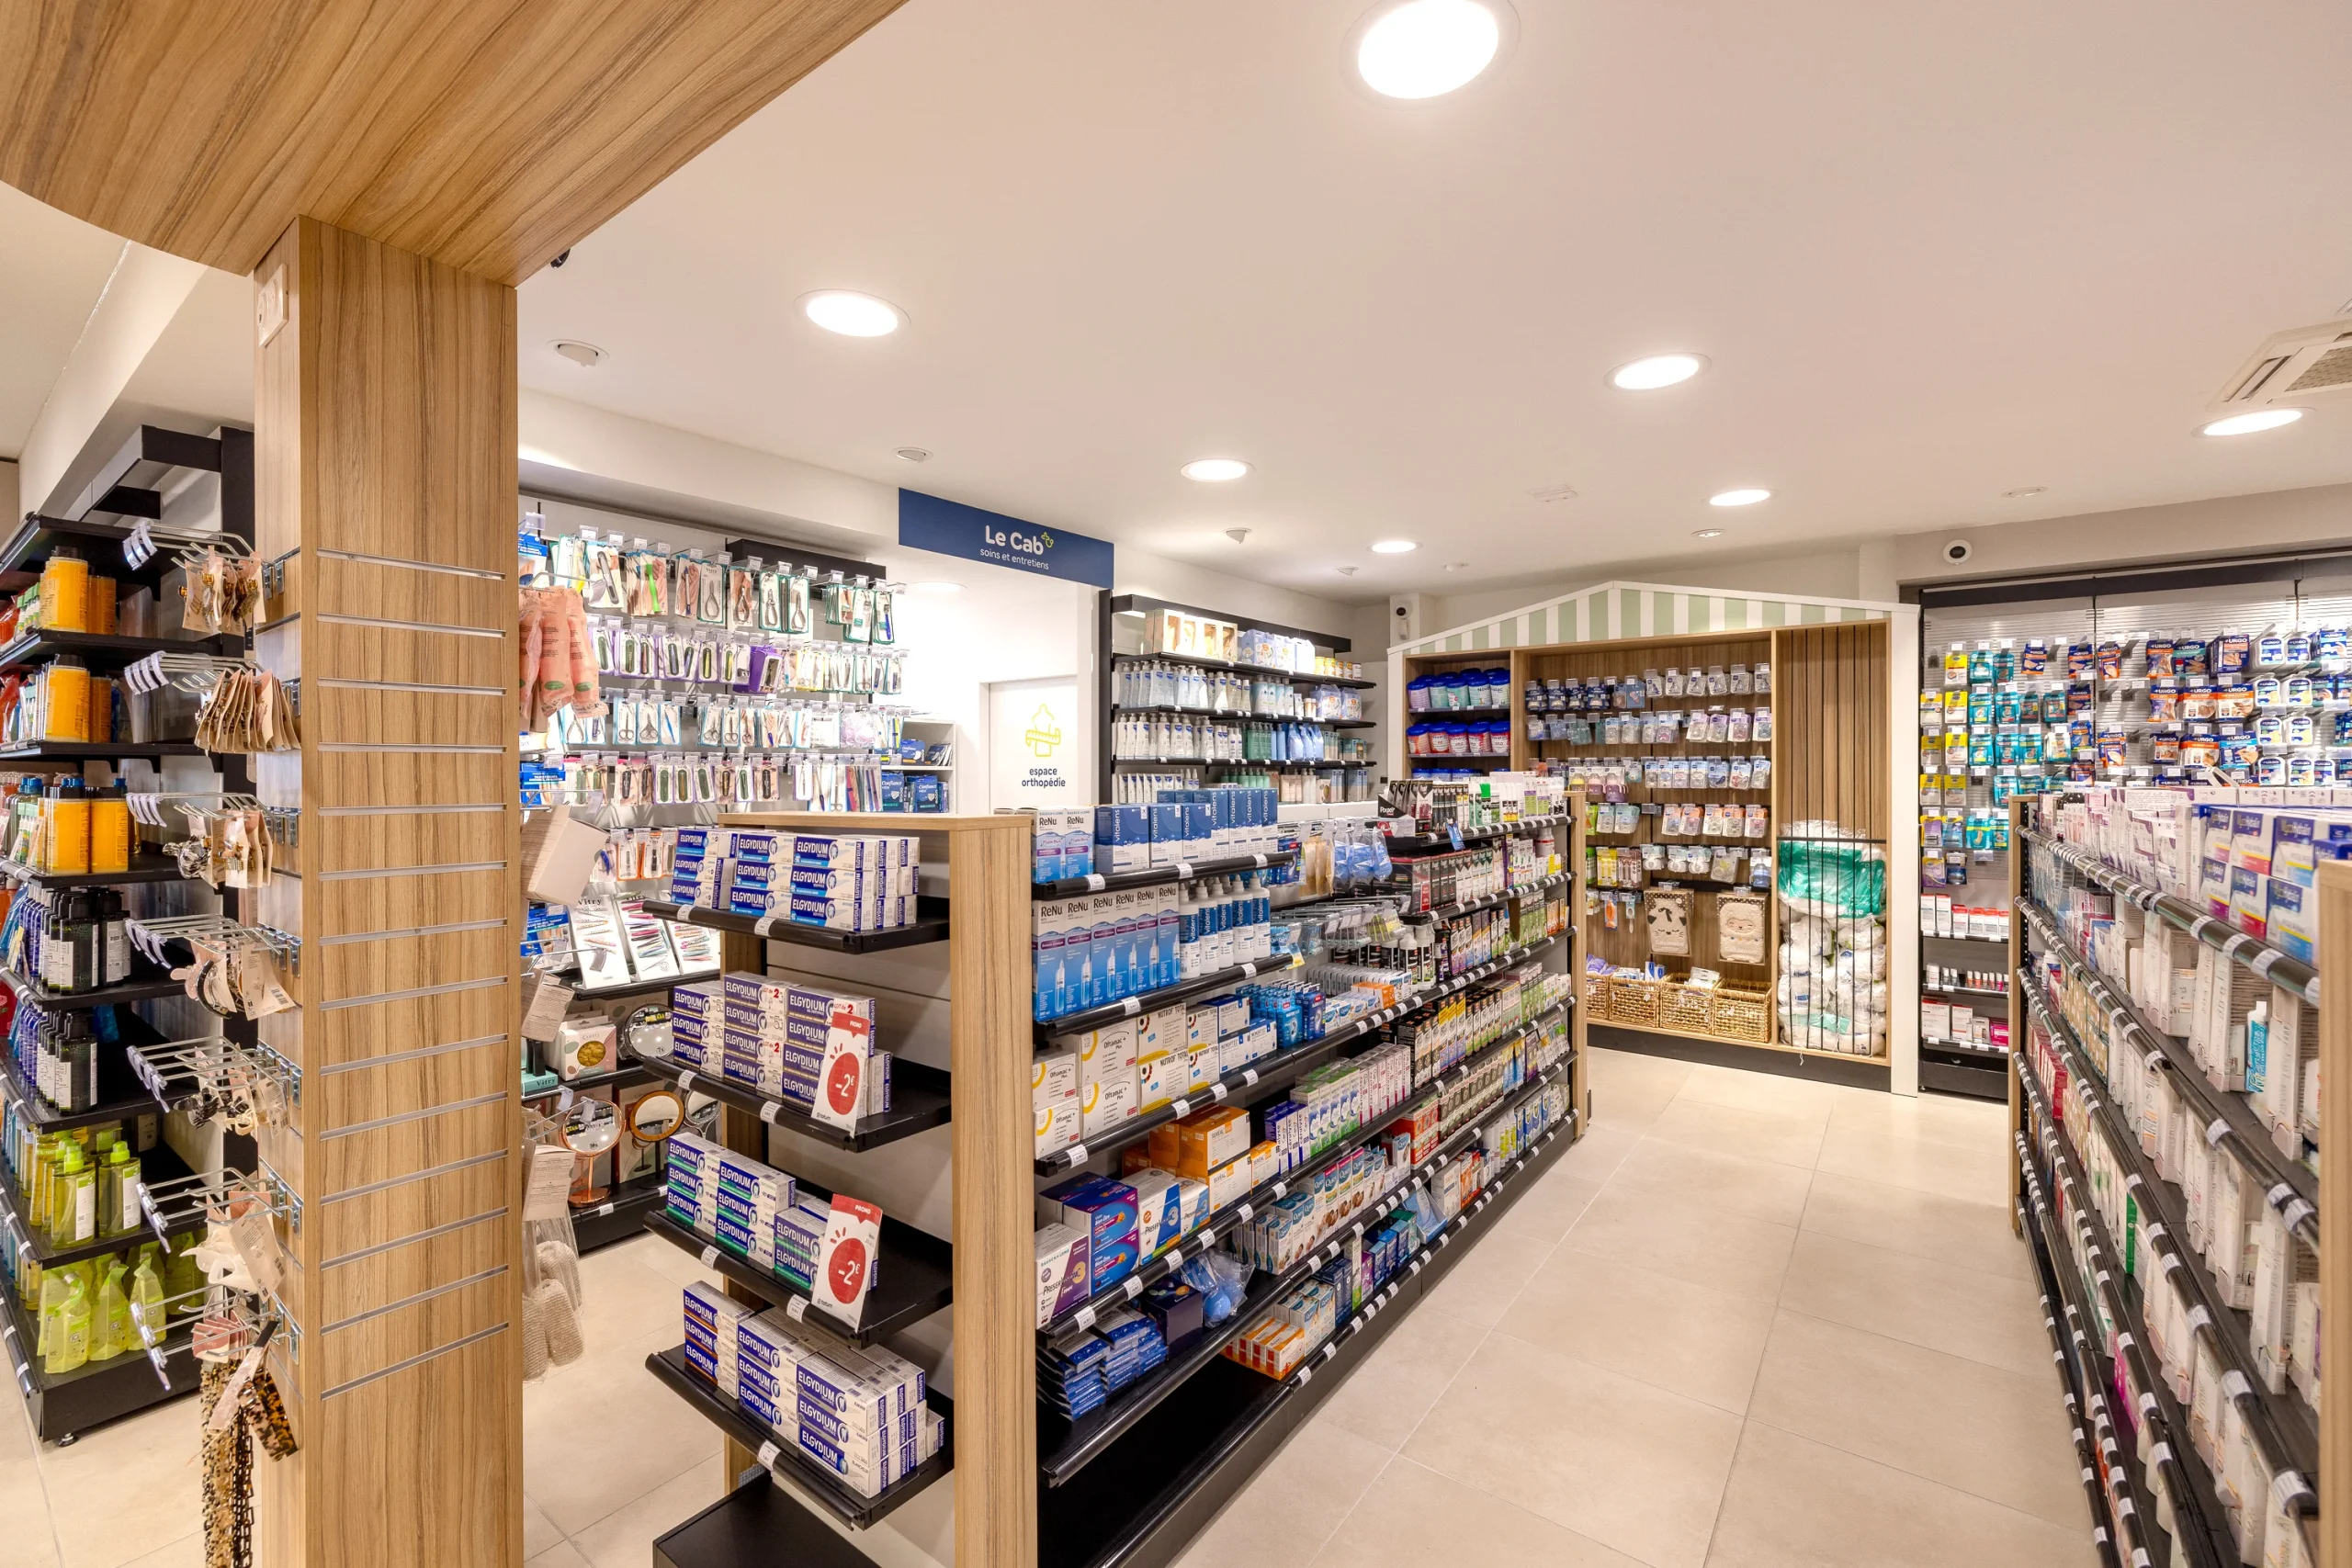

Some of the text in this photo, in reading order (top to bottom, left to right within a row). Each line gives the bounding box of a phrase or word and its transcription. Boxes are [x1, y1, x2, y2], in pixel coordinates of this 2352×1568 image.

[985, 525, 1044, 555] Le Cab
[980, 548, 1049, 570] soins et entretiens
[1029, 768, 1057, 778] espace
[1021, 777, 1066, 788] orthopédie
[1039, 818, 1057, 826] ReNu
[1067, 816, 1084, 825] ReNu
[680, 835, 702, 843] ELGYDIUM
[740, 839, 768, 849] ELGYDIUM
[797, 841, 828, 855] ELGYDIUM
[675, 860, 697, 869] ELGYDIUM
[737, 865, 767, 878] ELGYDIUM
[792, 871, 825, 884] ELGYDIUM
[673, 884, 695, 894] ELGYDIUM
[1137, 891, 1155, 901] ReNu
[1159, 887, 1176, 897] ReNu
[578, 898, 602, 906] Vitry
[732, 891, 764, 905] ELGYDIUM
[1093, 898, 1113, 908] ReNu
[1116, 894, 1134, 905] ReNu
[792, 899, 825, 912] ELGYDIUM
[1041, 906, 1063, 917] ReNu
[1067, 902, 1089, 913] ReNu
[726, 981, 757, 998] ELGYDIUM
[773, 988, 779, 998] 2
[675, 992, 702, 1008] ELGYDIUM
[790, 995, 825, 1012] ELGYDIUM
[726, 1007, 757, 1023] ELGYDIUM
[847, 1004, 854, 1014] 2
[1157, 1010, 1173, 1018] NUTROF
[673, 1017, 701, 1033] ELGYDIUM
[789, 1023, 825, 1040] ELGYDIUM
[725, 1033, 756, 1051] ELGYDIUM
[774, 1042, 780, 1053] 2
[675, 1041, 700, 1058] ELGYDIUM
[785, 1050, 819, 1070] ELGYDIUM
[1160, 1057, 1175, 1067] NUTROF
[725, 1059, 755, 1077] ELGYDIUM
[536, 1078, 556, 1086] Vitry
[784, 1078, 817, 1098] ELGYDIUM
[670, 1142, 697, 1162] ELGYDIUM
[1352, 1159, 1364, 1170] Quies
[669, 1168, 695, 1188] ELGYDIUM
[720, 1166, 751, 1188] ELGYDIUM
[1339, 1167, 1351, 1179] Quies
[1325, 1175, 1337, 1188] Quies
[668, 1192, 694, 1213] ELGYDIUM
[718, 1192, 749, 1215] ELGYDIUM
[855, 1204, 871, 1215] PROMO
[1303, 1201, 1314, 1213] Quies
[1293, 1210, 1303, 1221] Quies
[717, 1219, 747, 1243] ELGYDIUM
[777, 1222, 810, 1248] ELGYDIUM
[776, 1250, 809, 1276] ELGYDIUM
[685, 1295, 713, 1321] ELGYDIUM
[685, 1321, 713, 1346] ELGYDIUM
[738, 1331, 770, 1359] ELGYDIUM
[686, 1345, 713, 1371] ELGYDIUM
[738, 1360, 770, 1389] ELGYDIUM
[798, 1370, 835, 1402] ELGYDIUM
[740, 1385, 772, 1416] ELGYDIUM
[799, 1401, 837, 1433] ELGYDIUM
[802, 1430, 838, 1463] ELGYDIUM
